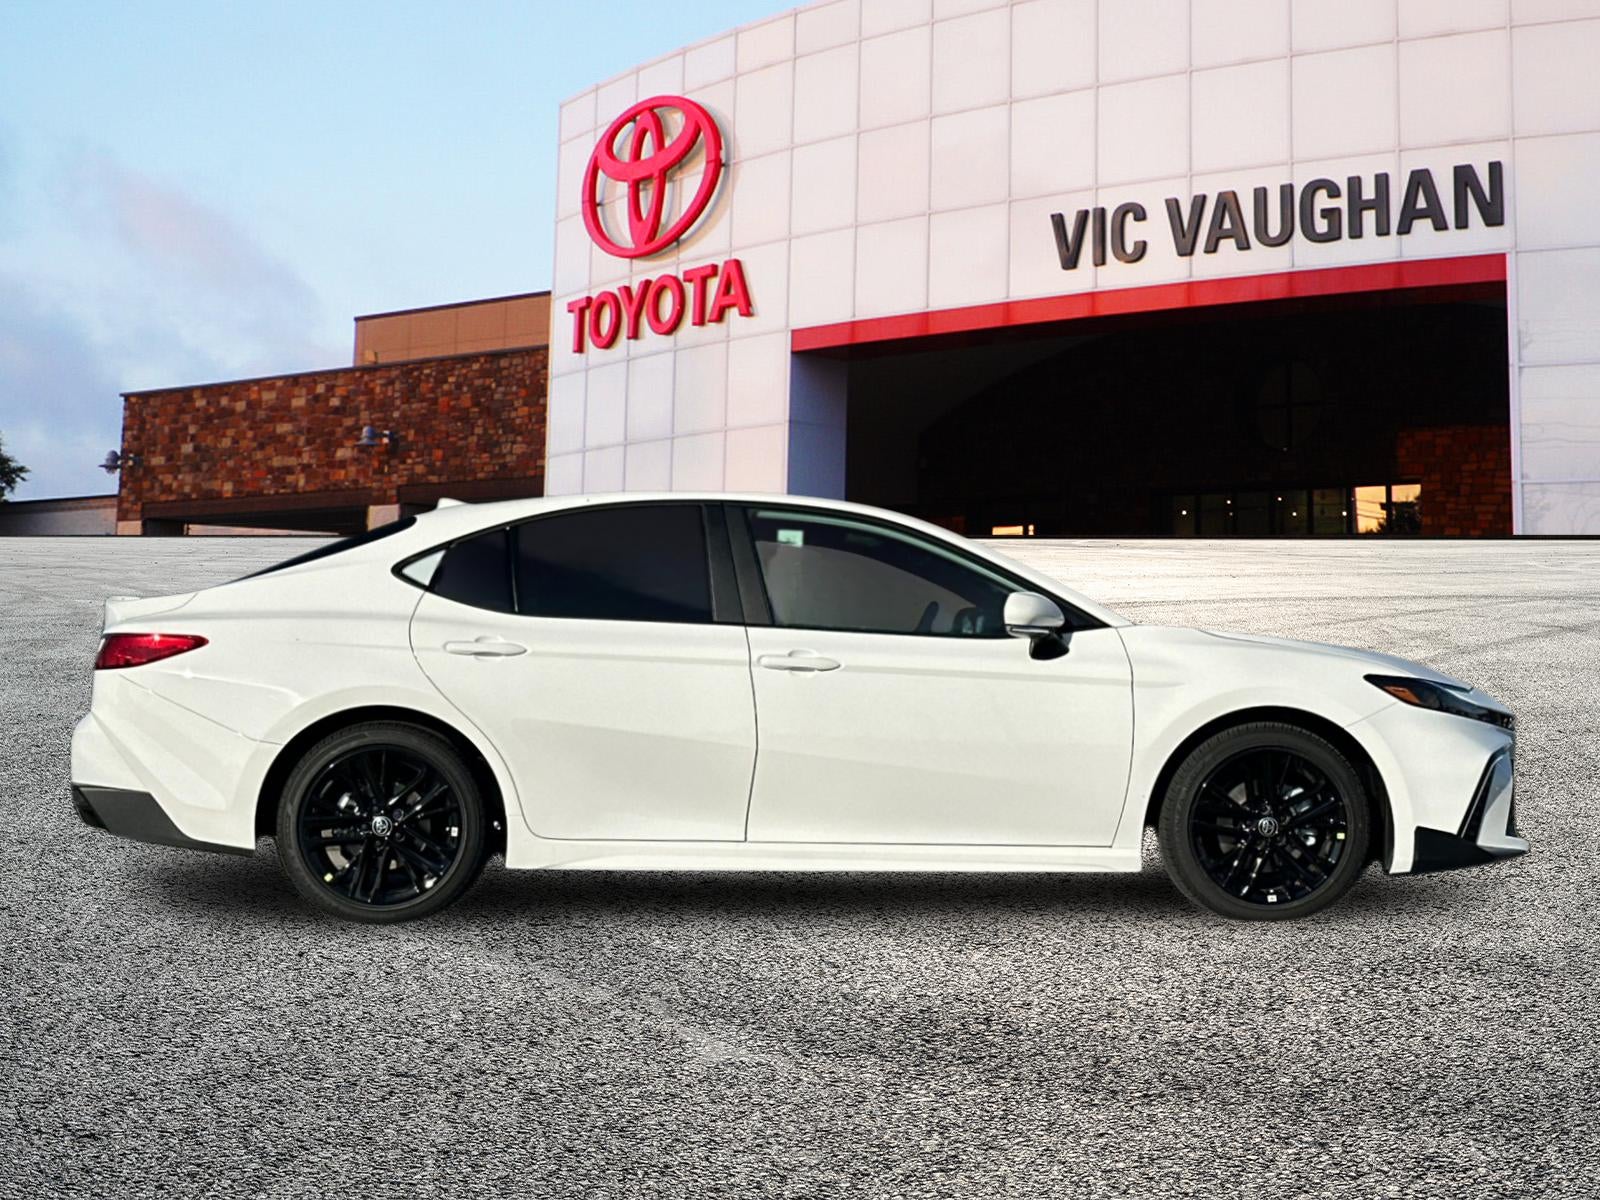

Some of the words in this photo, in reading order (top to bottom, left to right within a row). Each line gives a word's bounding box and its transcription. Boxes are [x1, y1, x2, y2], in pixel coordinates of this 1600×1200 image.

[1050, 201, 1147, 270] VIC
[1165, 160, 1505, 257] VAUGHAN
[567, 258, 754, 353] TOYOTA
